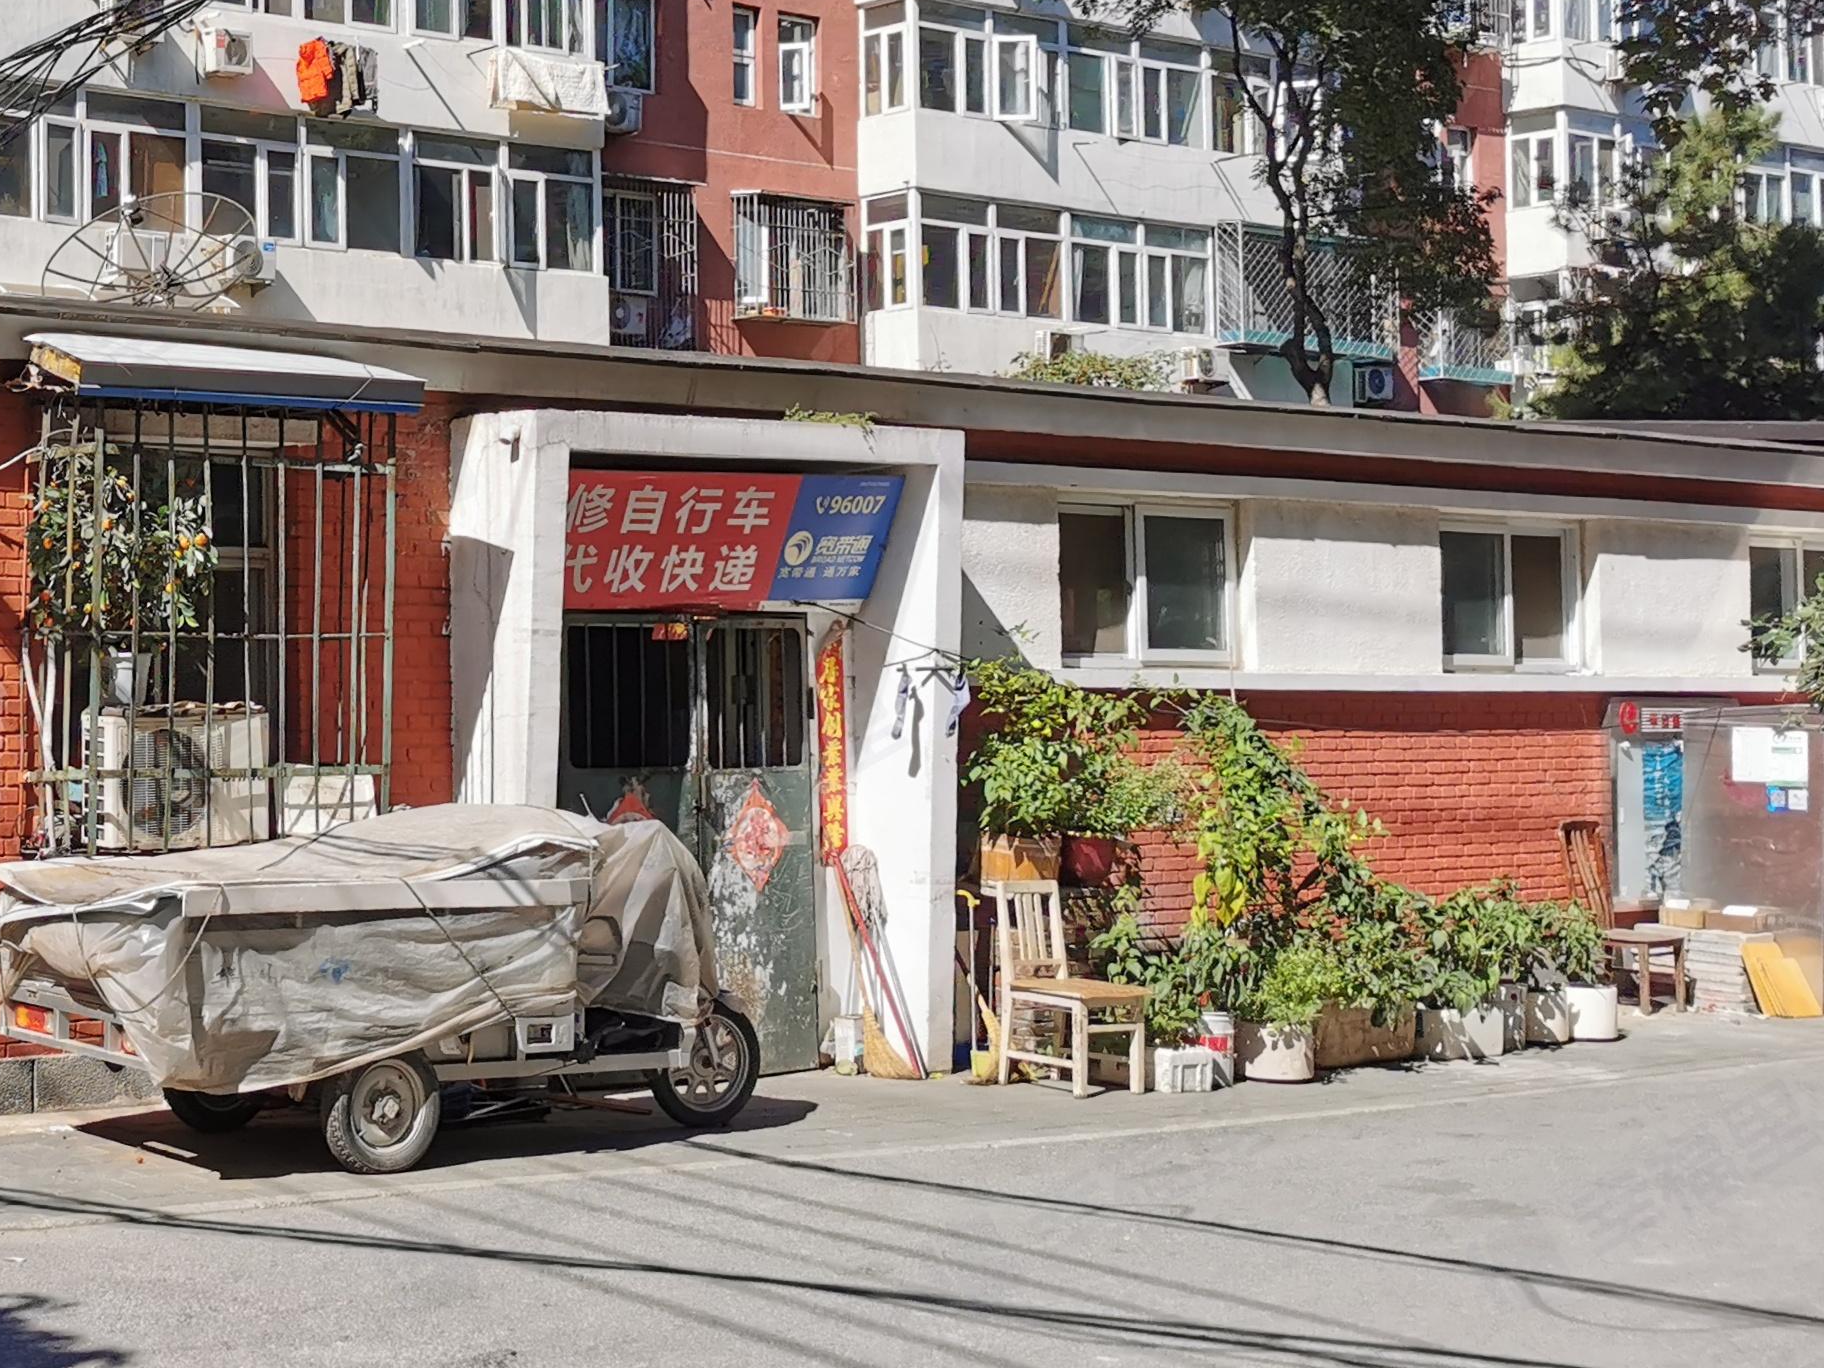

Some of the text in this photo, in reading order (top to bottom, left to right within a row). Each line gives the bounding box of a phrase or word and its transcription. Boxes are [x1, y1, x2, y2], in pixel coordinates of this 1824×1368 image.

[566, 484, 776, 535] 修自行车
[829, 495, 887, 514] 96007
